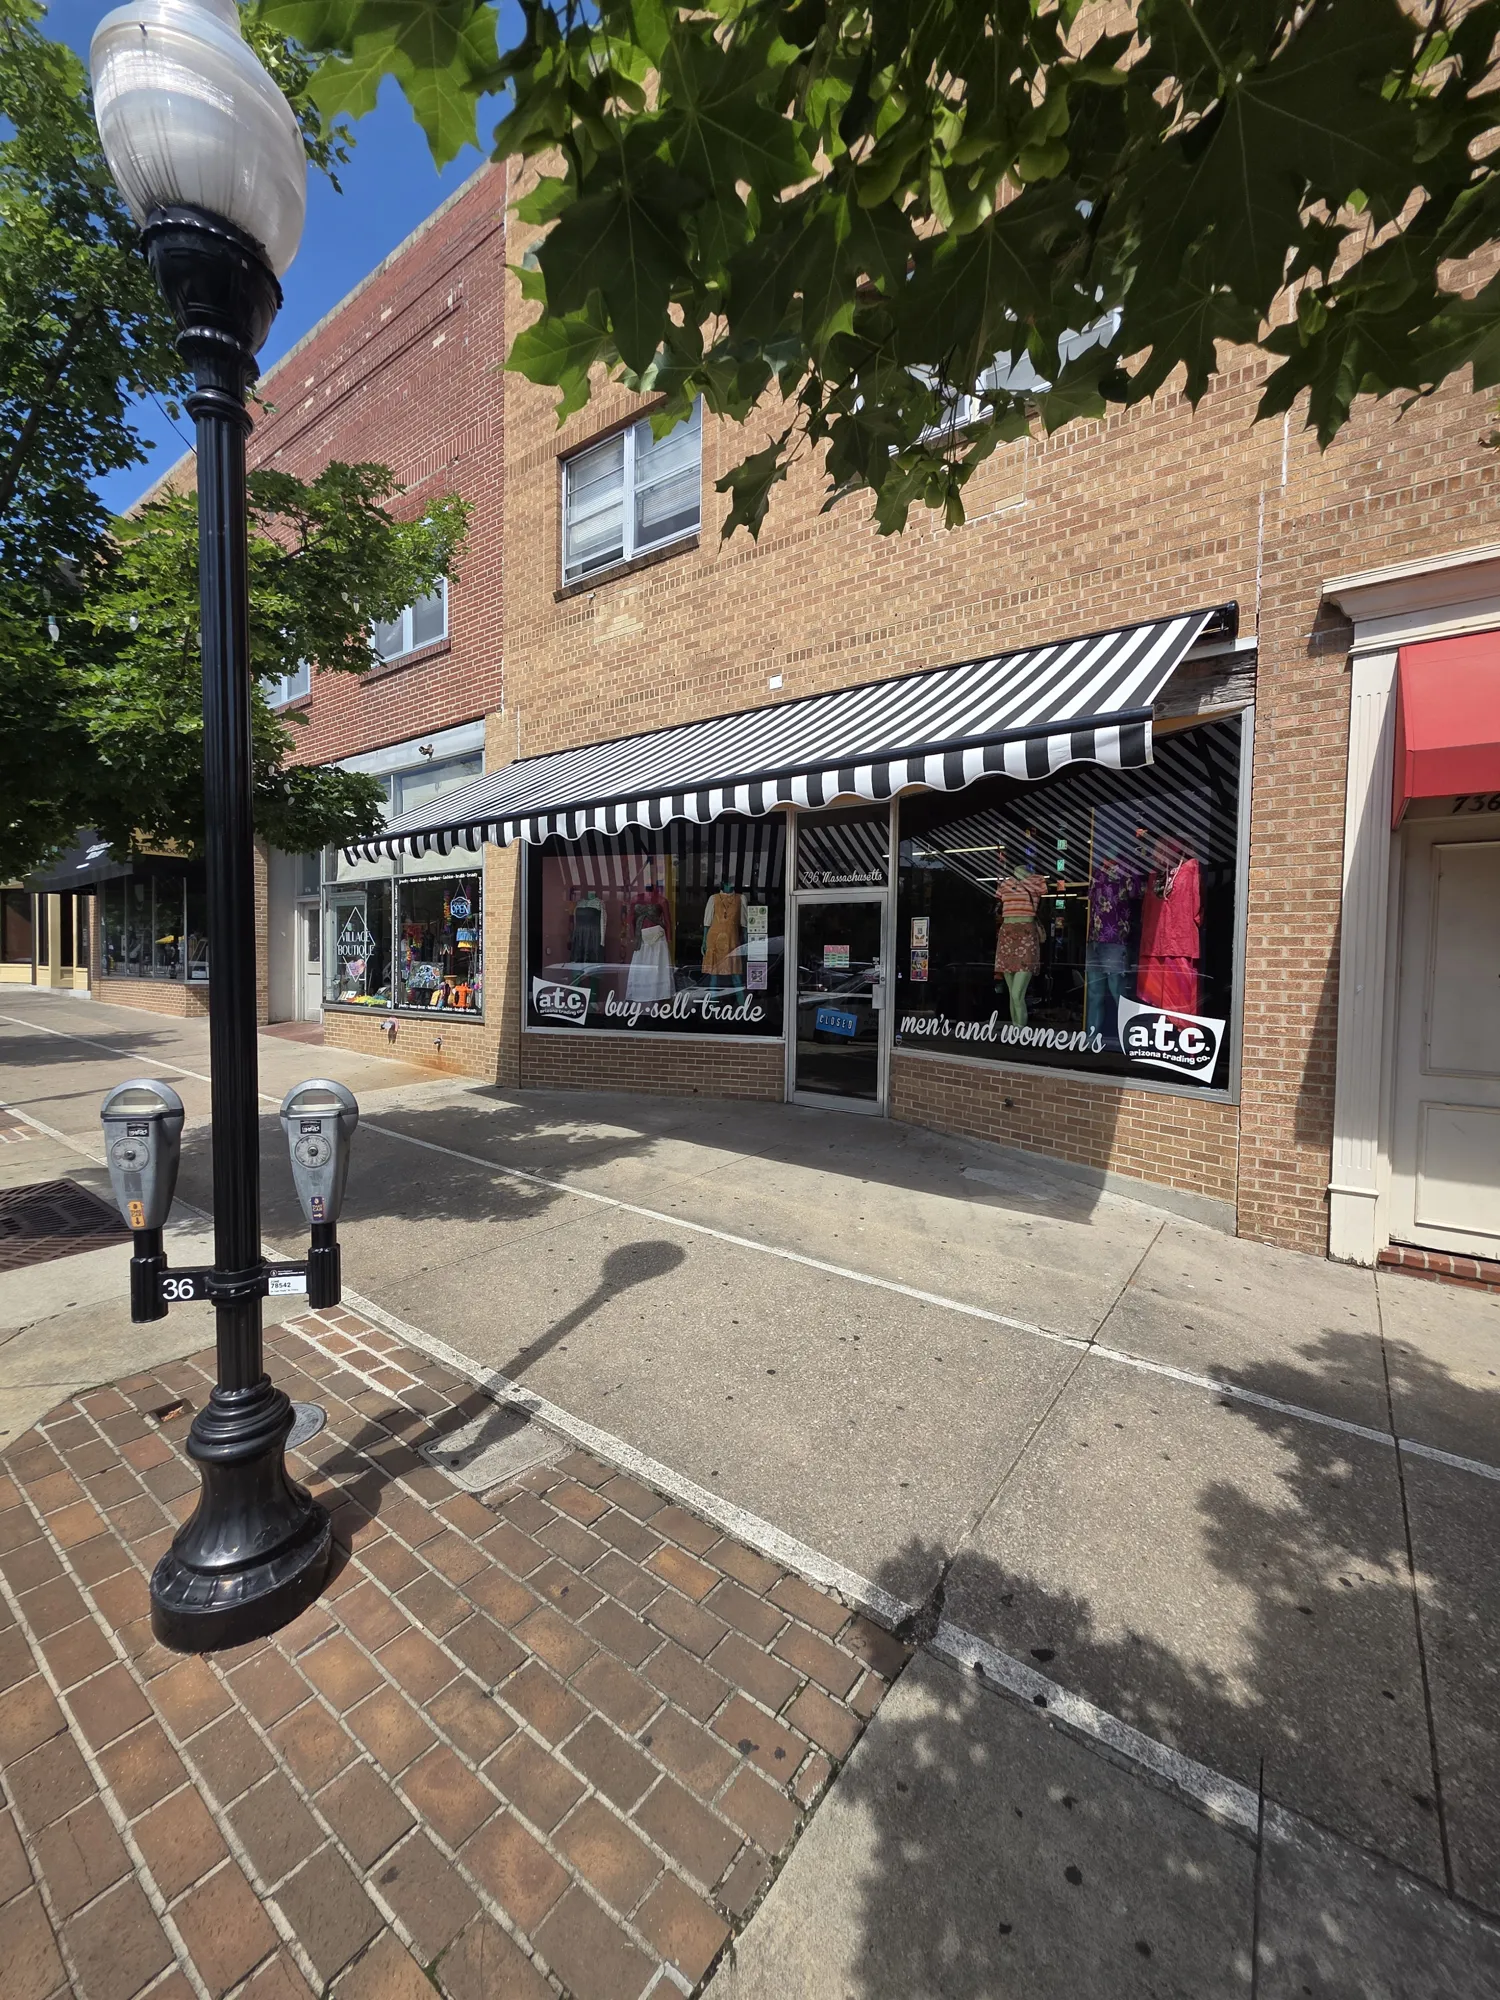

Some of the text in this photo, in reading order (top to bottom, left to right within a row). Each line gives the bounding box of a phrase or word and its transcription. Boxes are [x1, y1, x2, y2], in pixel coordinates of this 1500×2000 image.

[822, 869, 882, 883] Massachusetts
[451, 904, 469, 914] OPEN
[341, 931, 371, 942] VILLAGE
[337, 944, 374, 959] BOUTIQUE
[604, 989, 766, 1027] buy sell trade
[819, 1014, 853, 1030] CLOSED
[900, 1013, 951, 1036] men's
[955, 1010, 999, 1042] and
[1000, 1025, 1106, 1053] women's
[1128, 1015, 1210, 1054] a.t.c.
[1129, 1049, 1160, 1057] arizona
[1162, 1052, 1195, 1064] trading
[162, 1278, 195, 1300] 36
